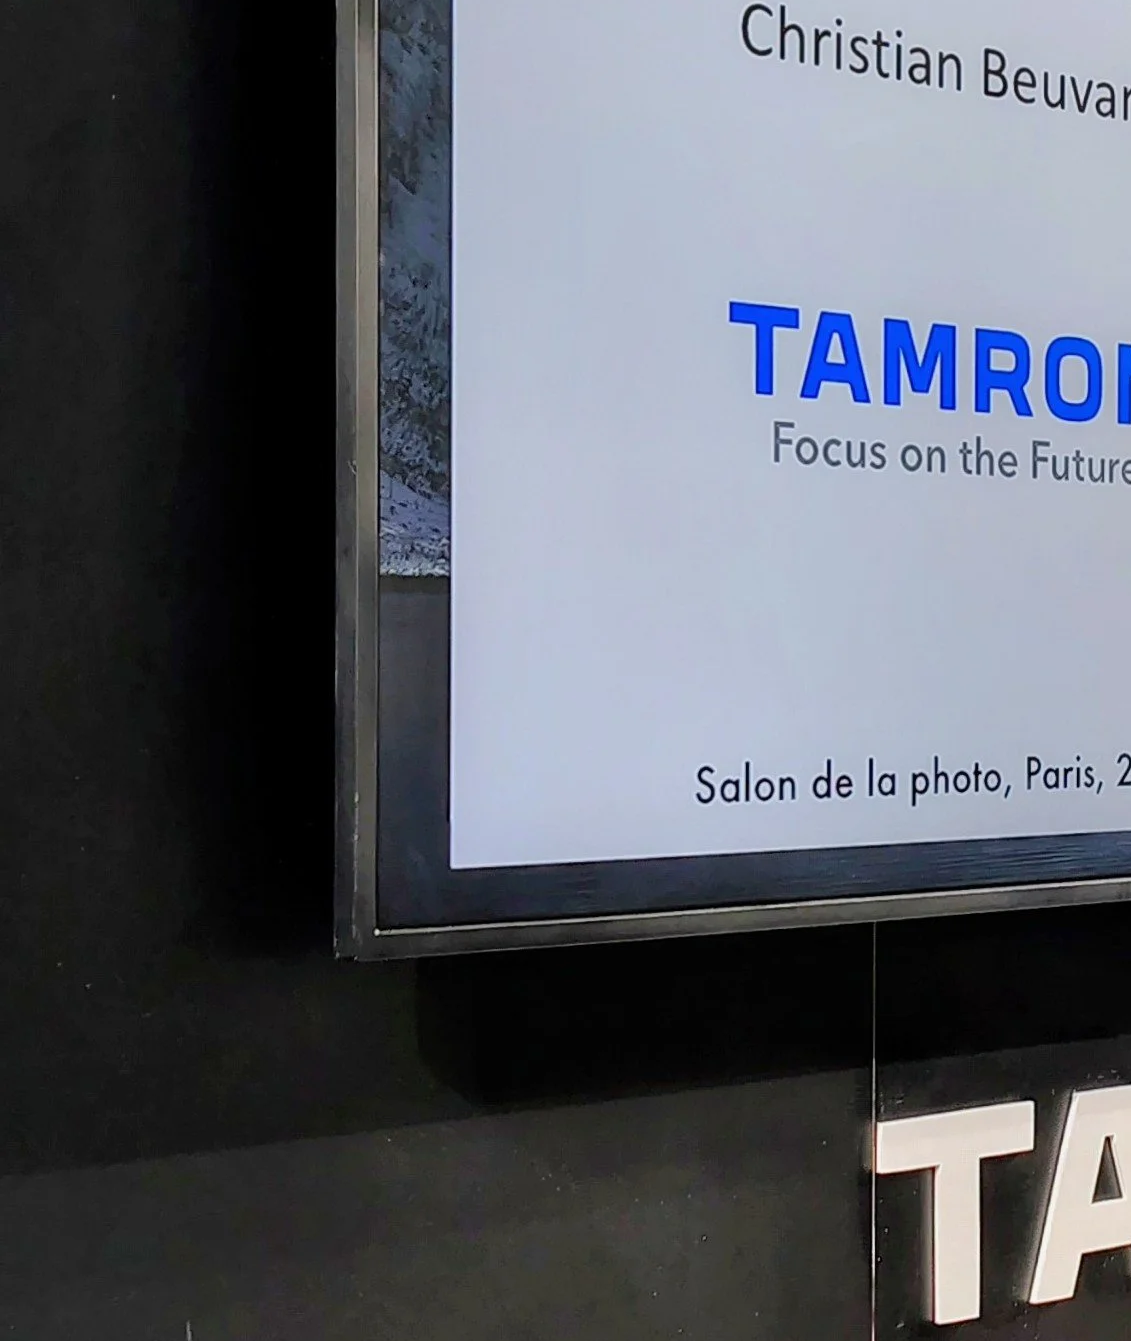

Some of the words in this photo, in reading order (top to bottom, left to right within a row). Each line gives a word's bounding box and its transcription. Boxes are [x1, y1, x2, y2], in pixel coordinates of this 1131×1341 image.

[741, 3, 962, 92] Christian
[773, 420, 887, 470] Focus
[900, 444, 946, 474] on
[958, 435, 1018, 478] the
[695, 760, 797, 805] Salon
[811, 758, 854, 800] de
[868, 757, 897, 797] la
[911, 755, 1012, 808] photo,
[1026, 755, 1104, 795] Paris,
